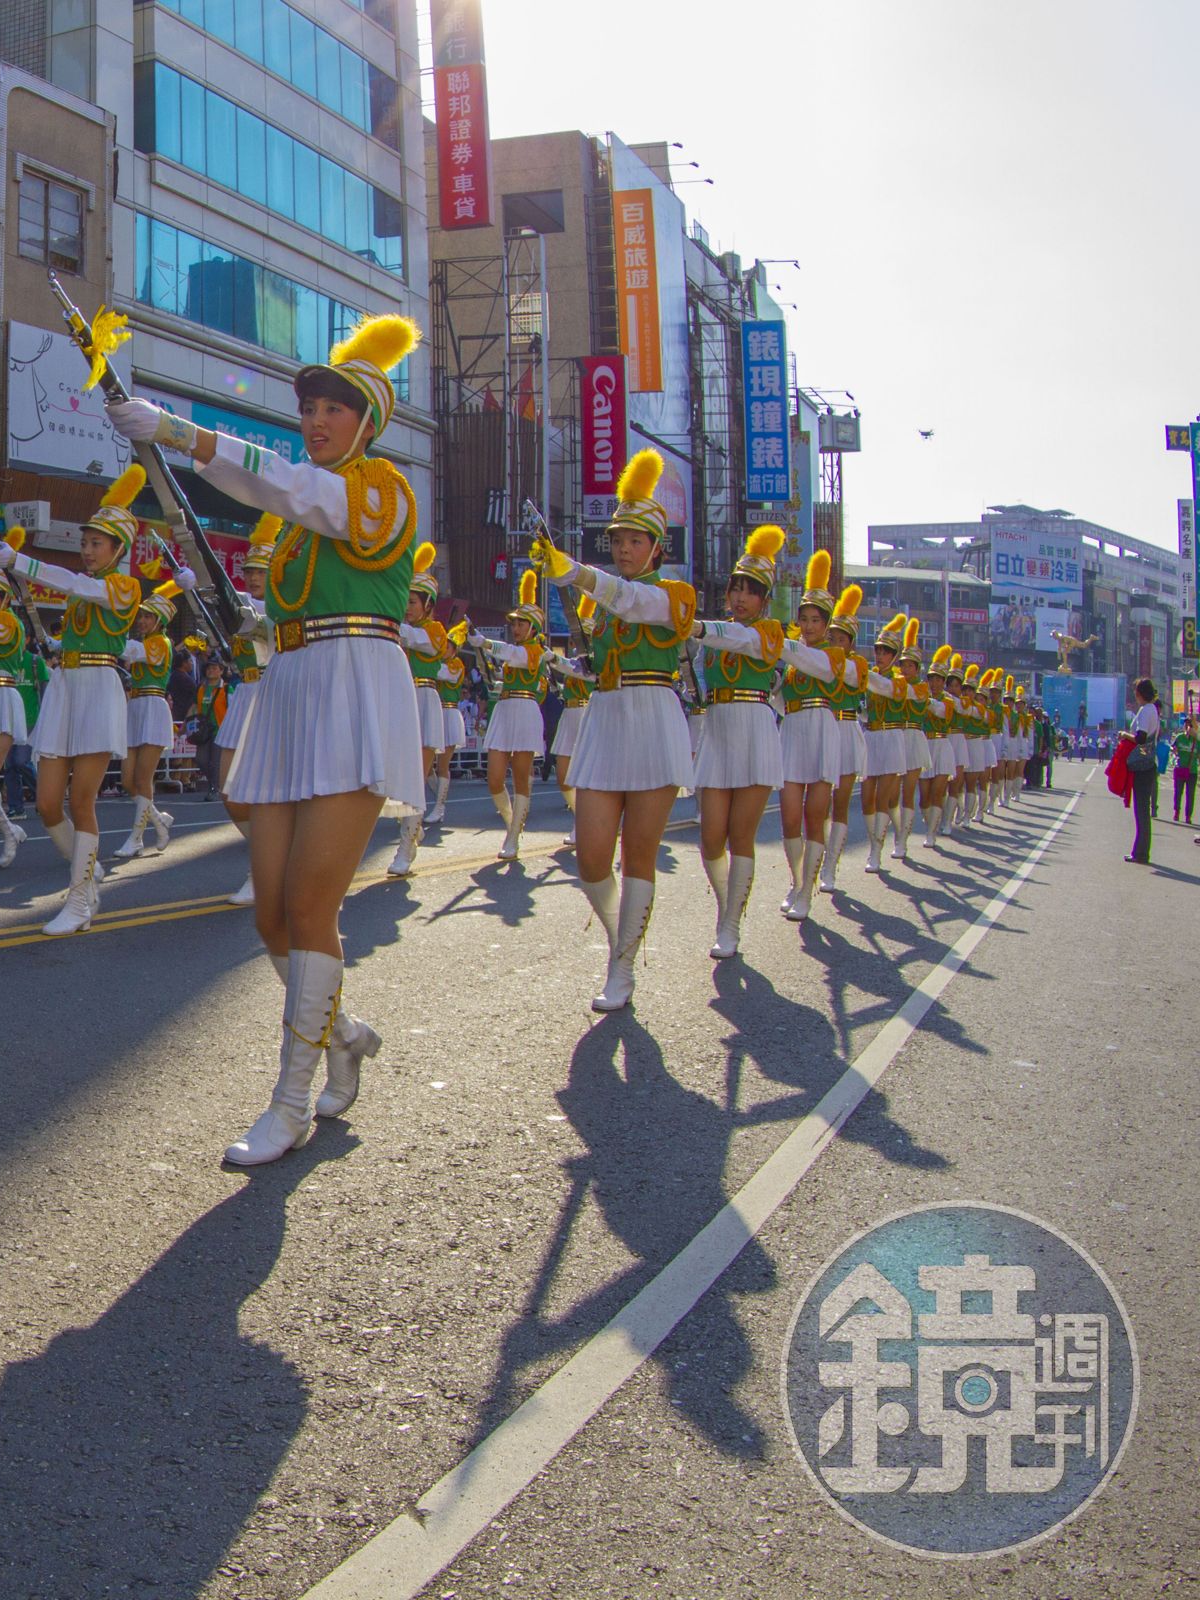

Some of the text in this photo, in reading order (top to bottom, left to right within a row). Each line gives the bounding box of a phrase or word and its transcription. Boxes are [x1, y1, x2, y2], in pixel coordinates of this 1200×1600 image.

[621, 202, 649, 289] 百威旅遊
[592, 364, 616, 483] Canon
[747, 474, 788, 497] 流行館
[749, 511, 788, 523] CITIZEN
[995, 531, 1028, 542] HITACHI
